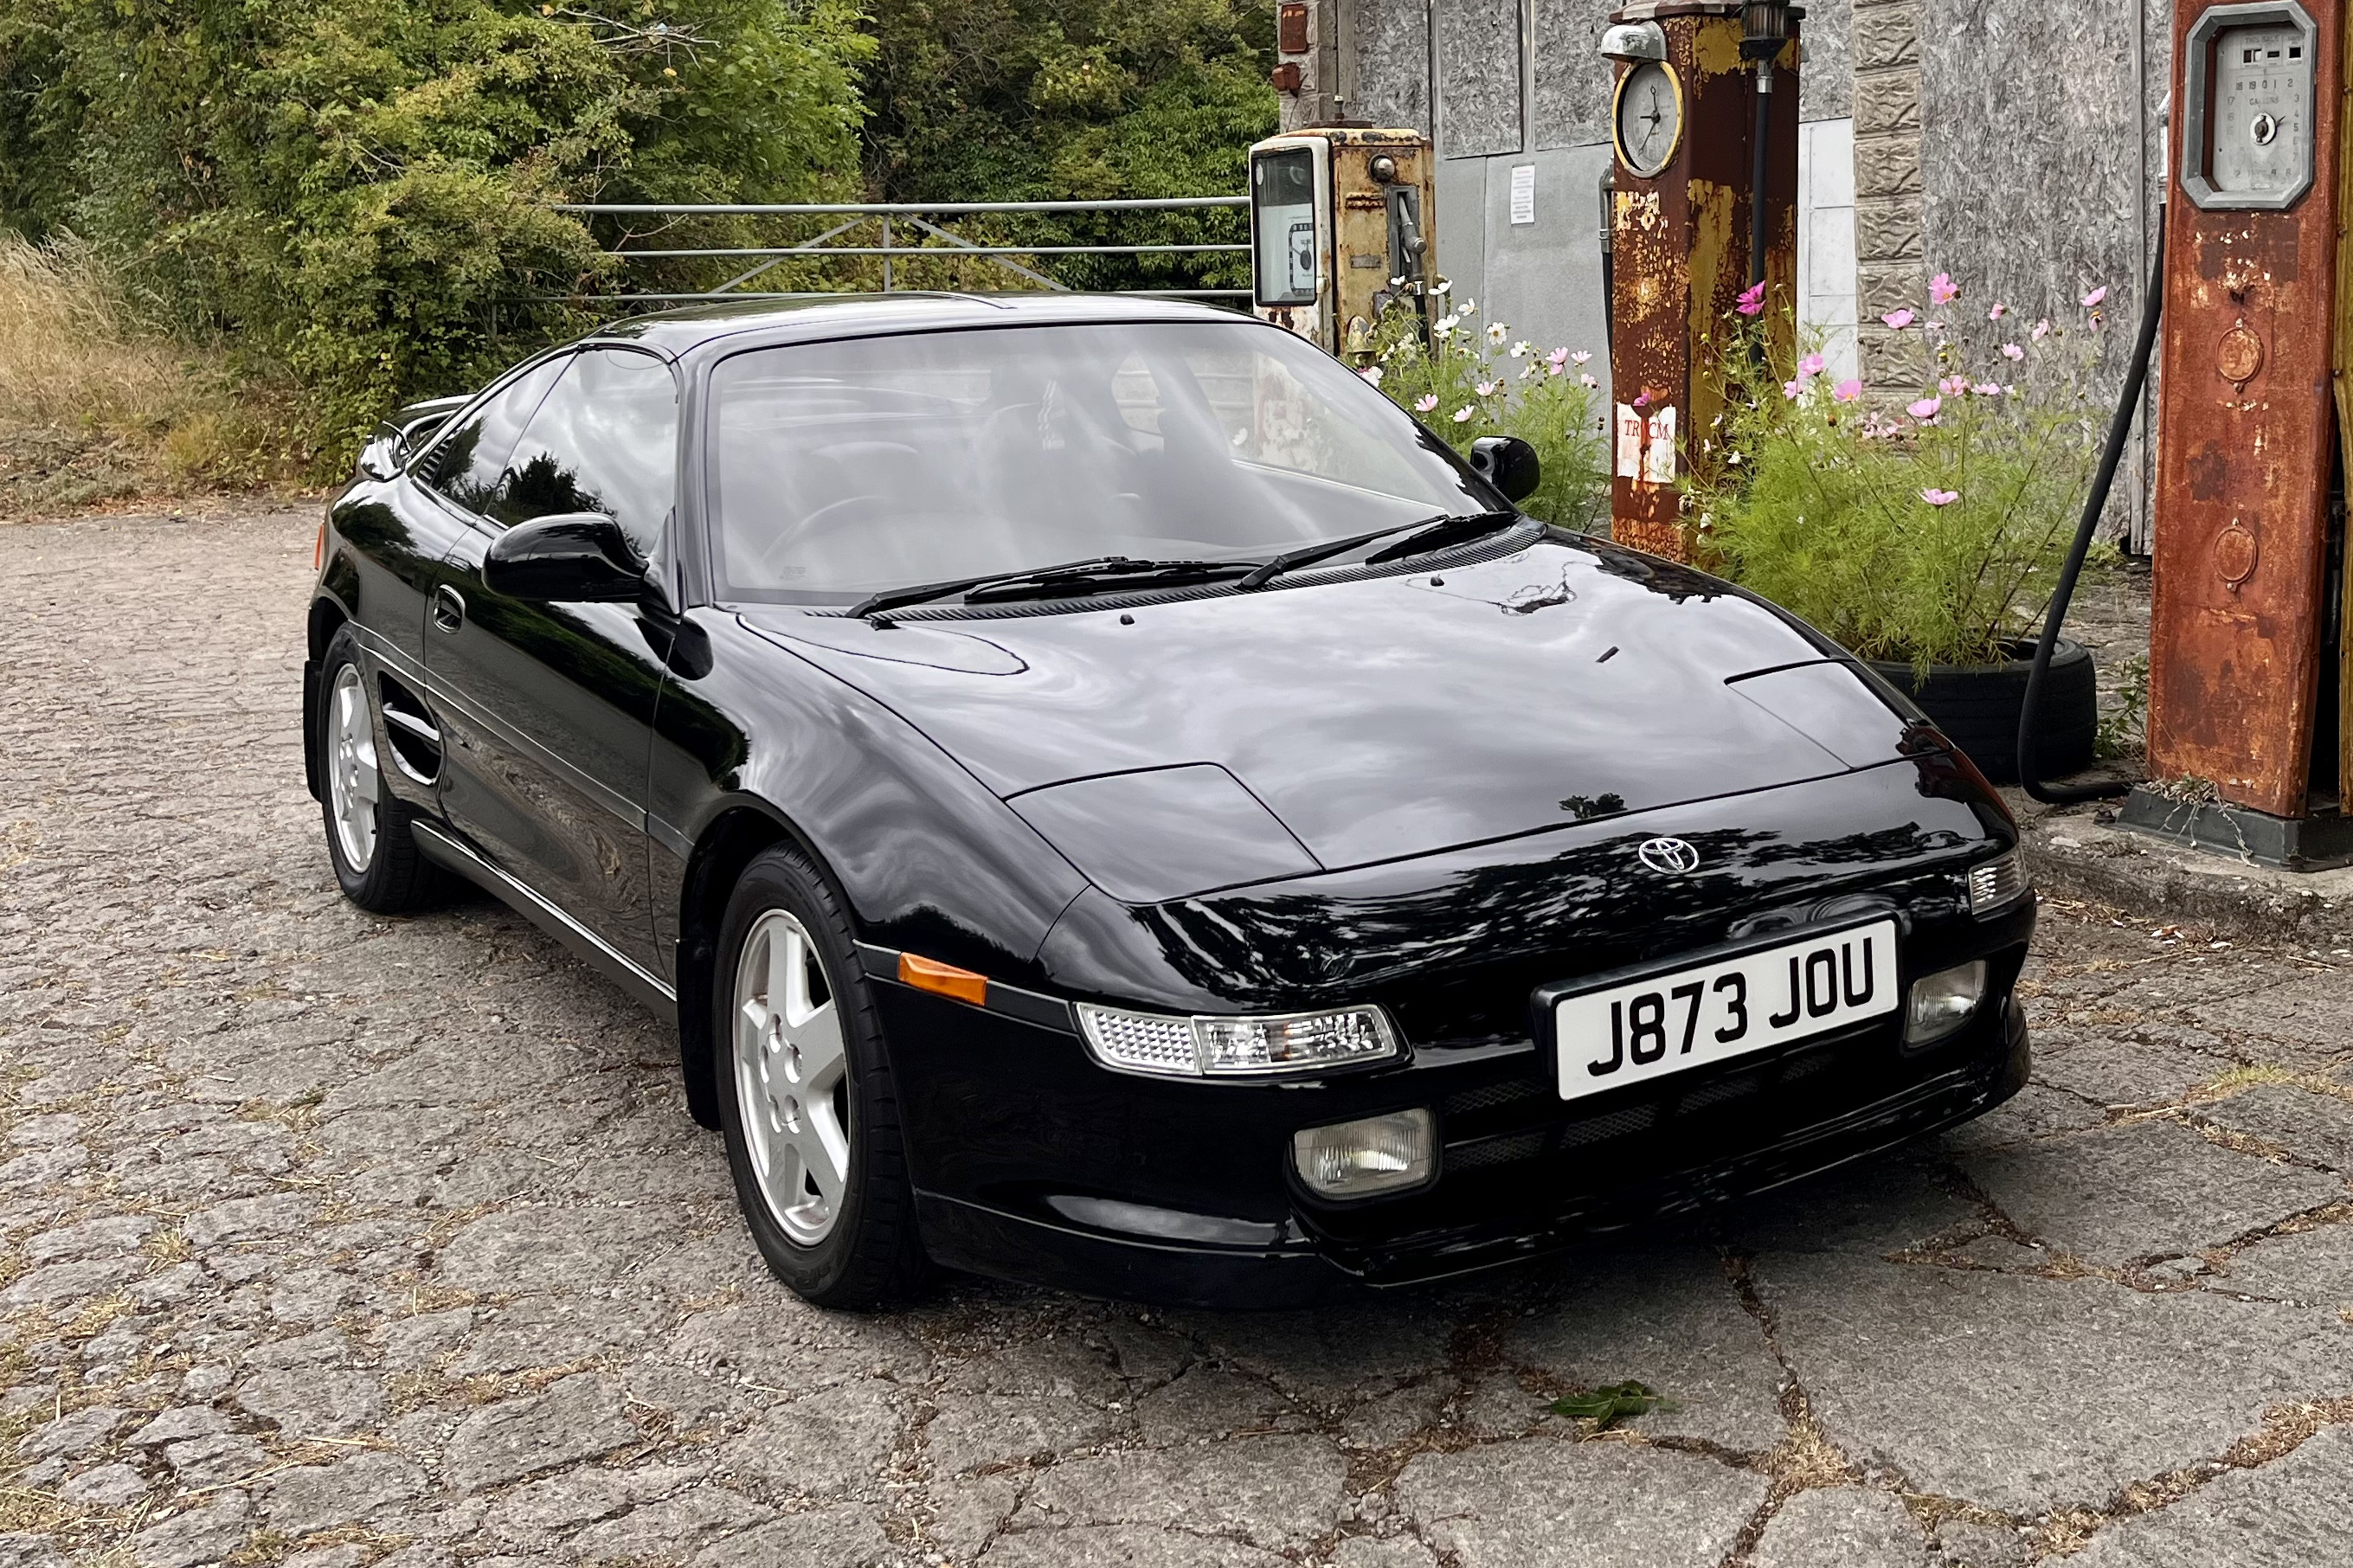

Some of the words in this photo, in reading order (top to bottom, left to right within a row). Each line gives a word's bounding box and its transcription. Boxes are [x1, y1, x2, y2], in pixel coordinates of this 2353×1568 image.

[2235, 81, 2243, 91] 18
[2249, 80, 2256, 90] 19
[2262, 80, 2267, 89] 0
[2287, 78, 2293, 87] 2
[2228, 96, 2235, 106] 17
[2294, 93, 2300, 103] 3
[2293, 109, 2299, 118] 4
[2293, 122, 2299, 132] 5
[1624, 420, 1668, 440] TRCM
[1587, 971, 1748, 1076] J873
[1769, 936, 1874, 1029] JOU
